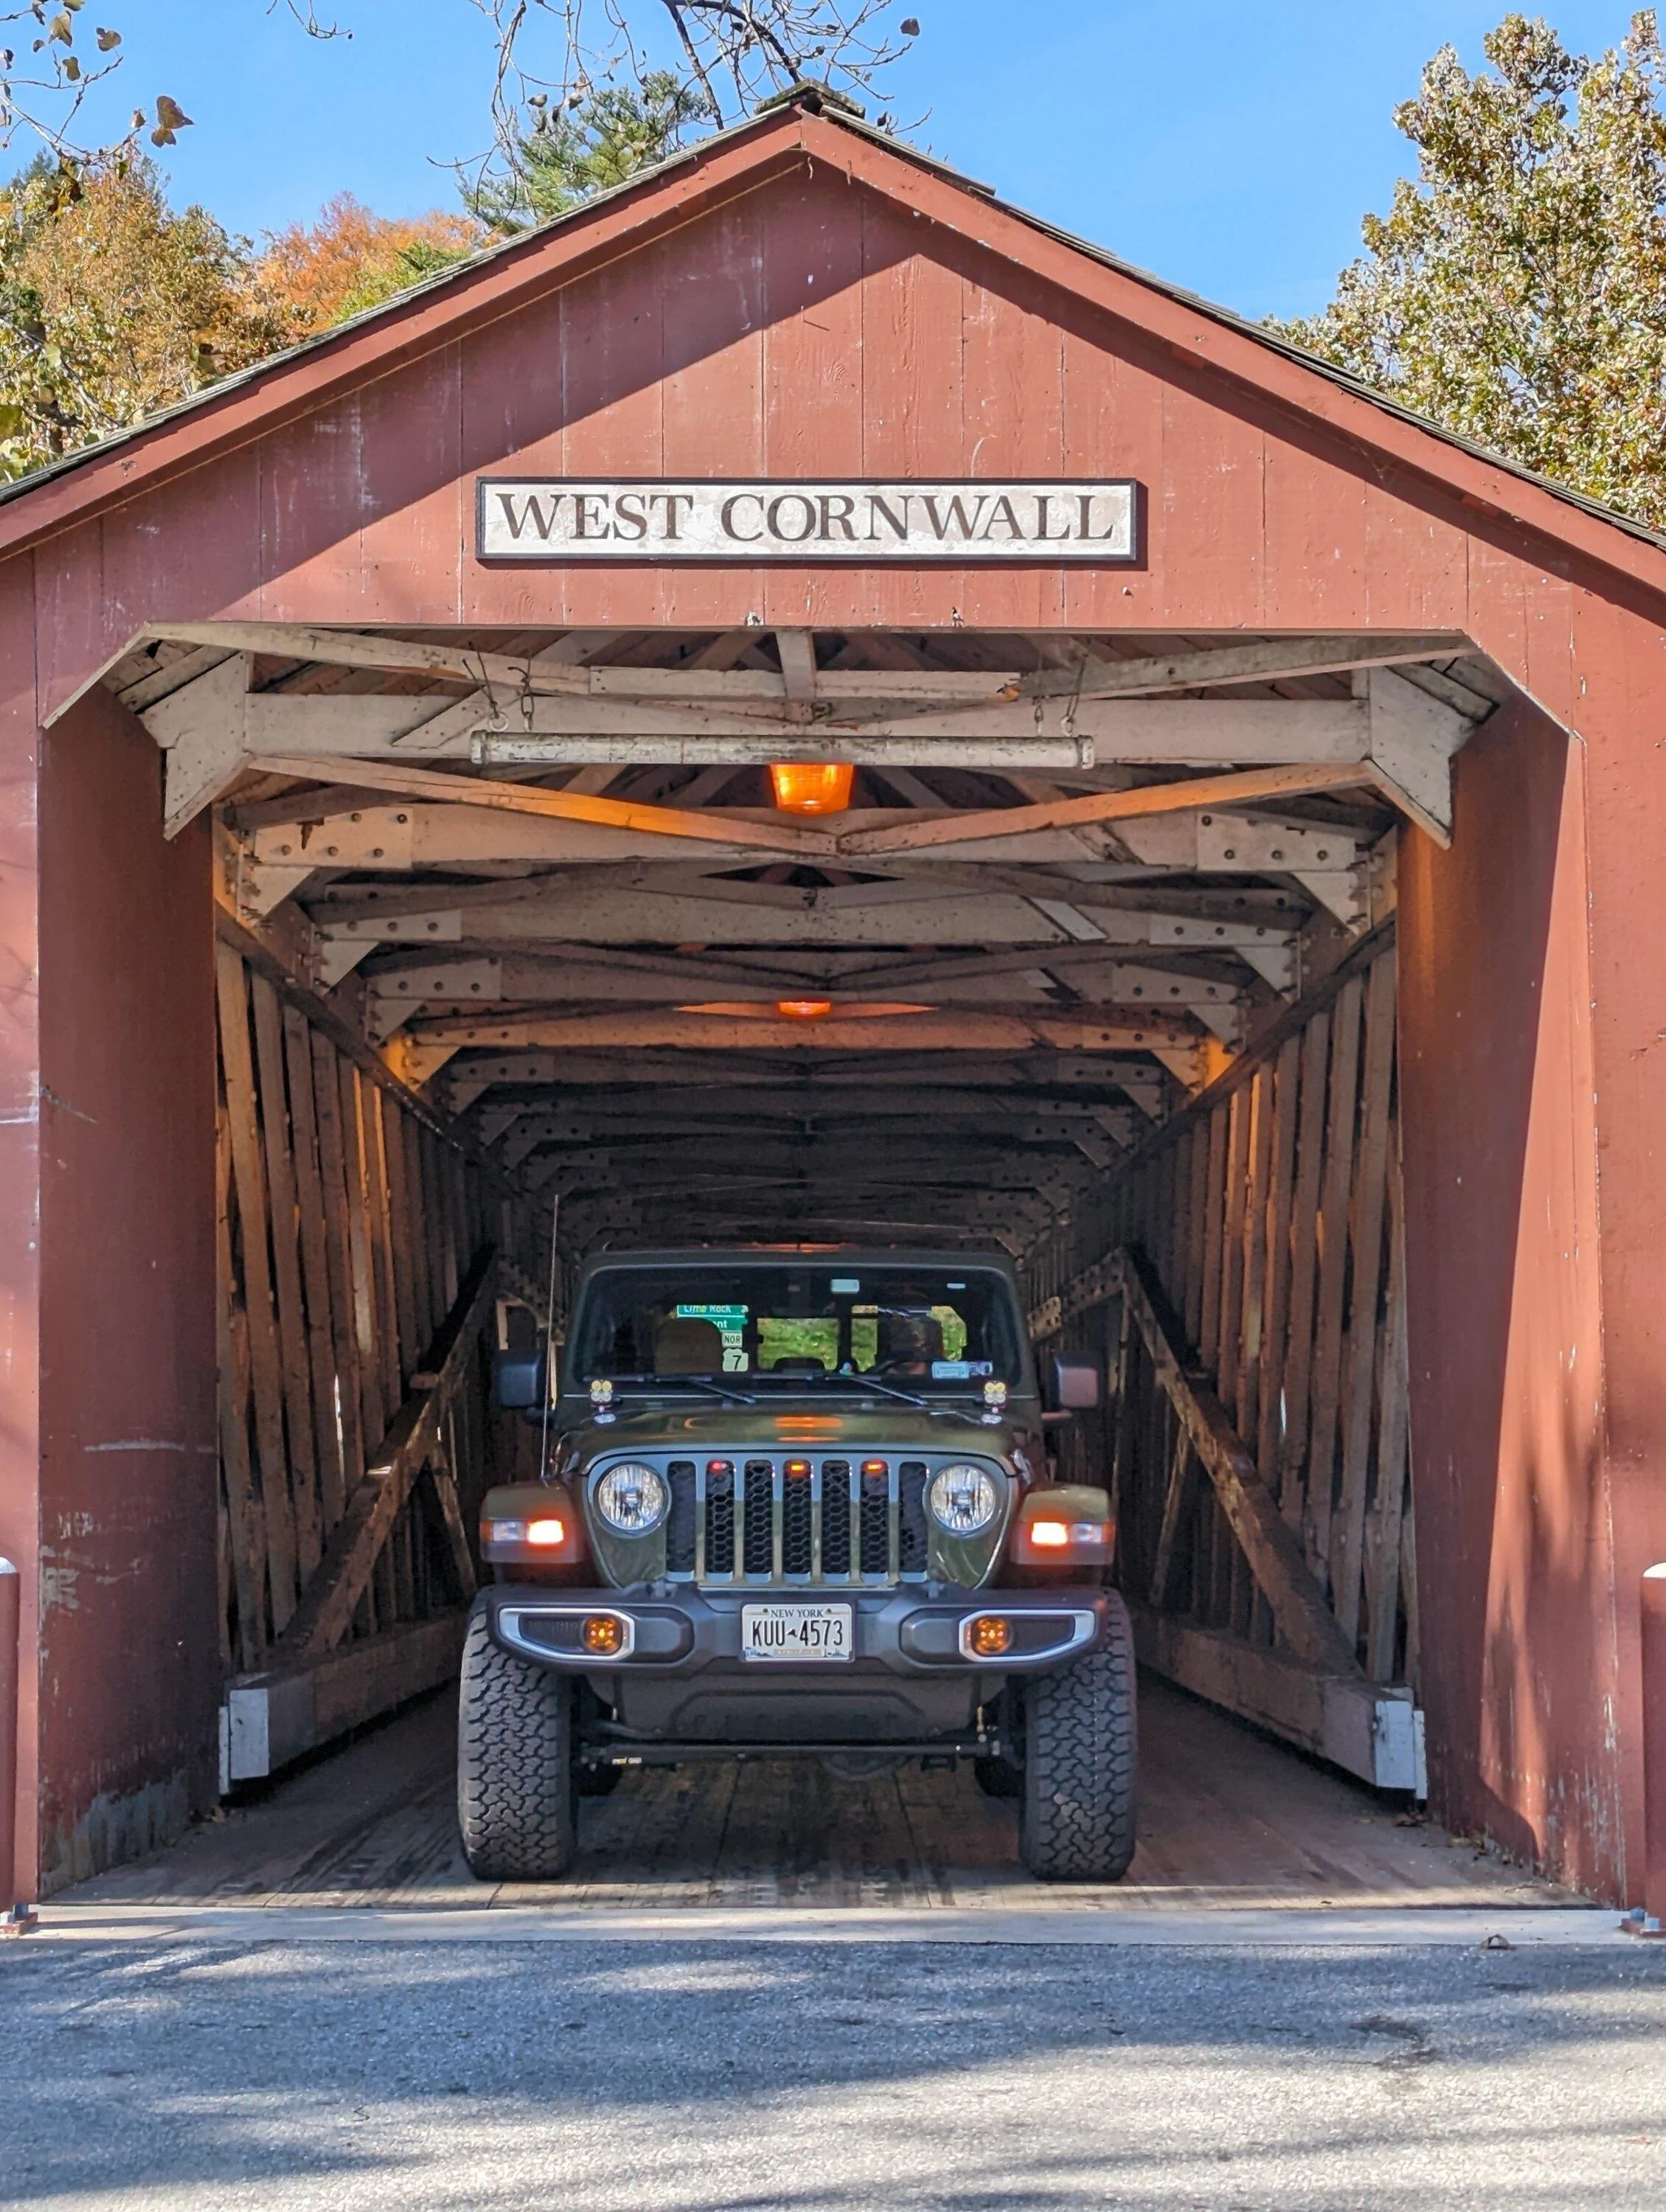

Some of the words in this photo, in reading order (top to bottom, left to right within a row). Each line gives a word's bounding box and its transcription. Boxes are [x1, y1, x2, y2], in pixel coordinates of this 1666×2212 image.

[496, 493, 693, 540] WEST
[720, 493, 1114, 542] CORNWALL
[732, 1354, 742, 1371] 7
[771, 1609, 794, 1618] NEW
[796, 1608, 824, 1618] YORK
